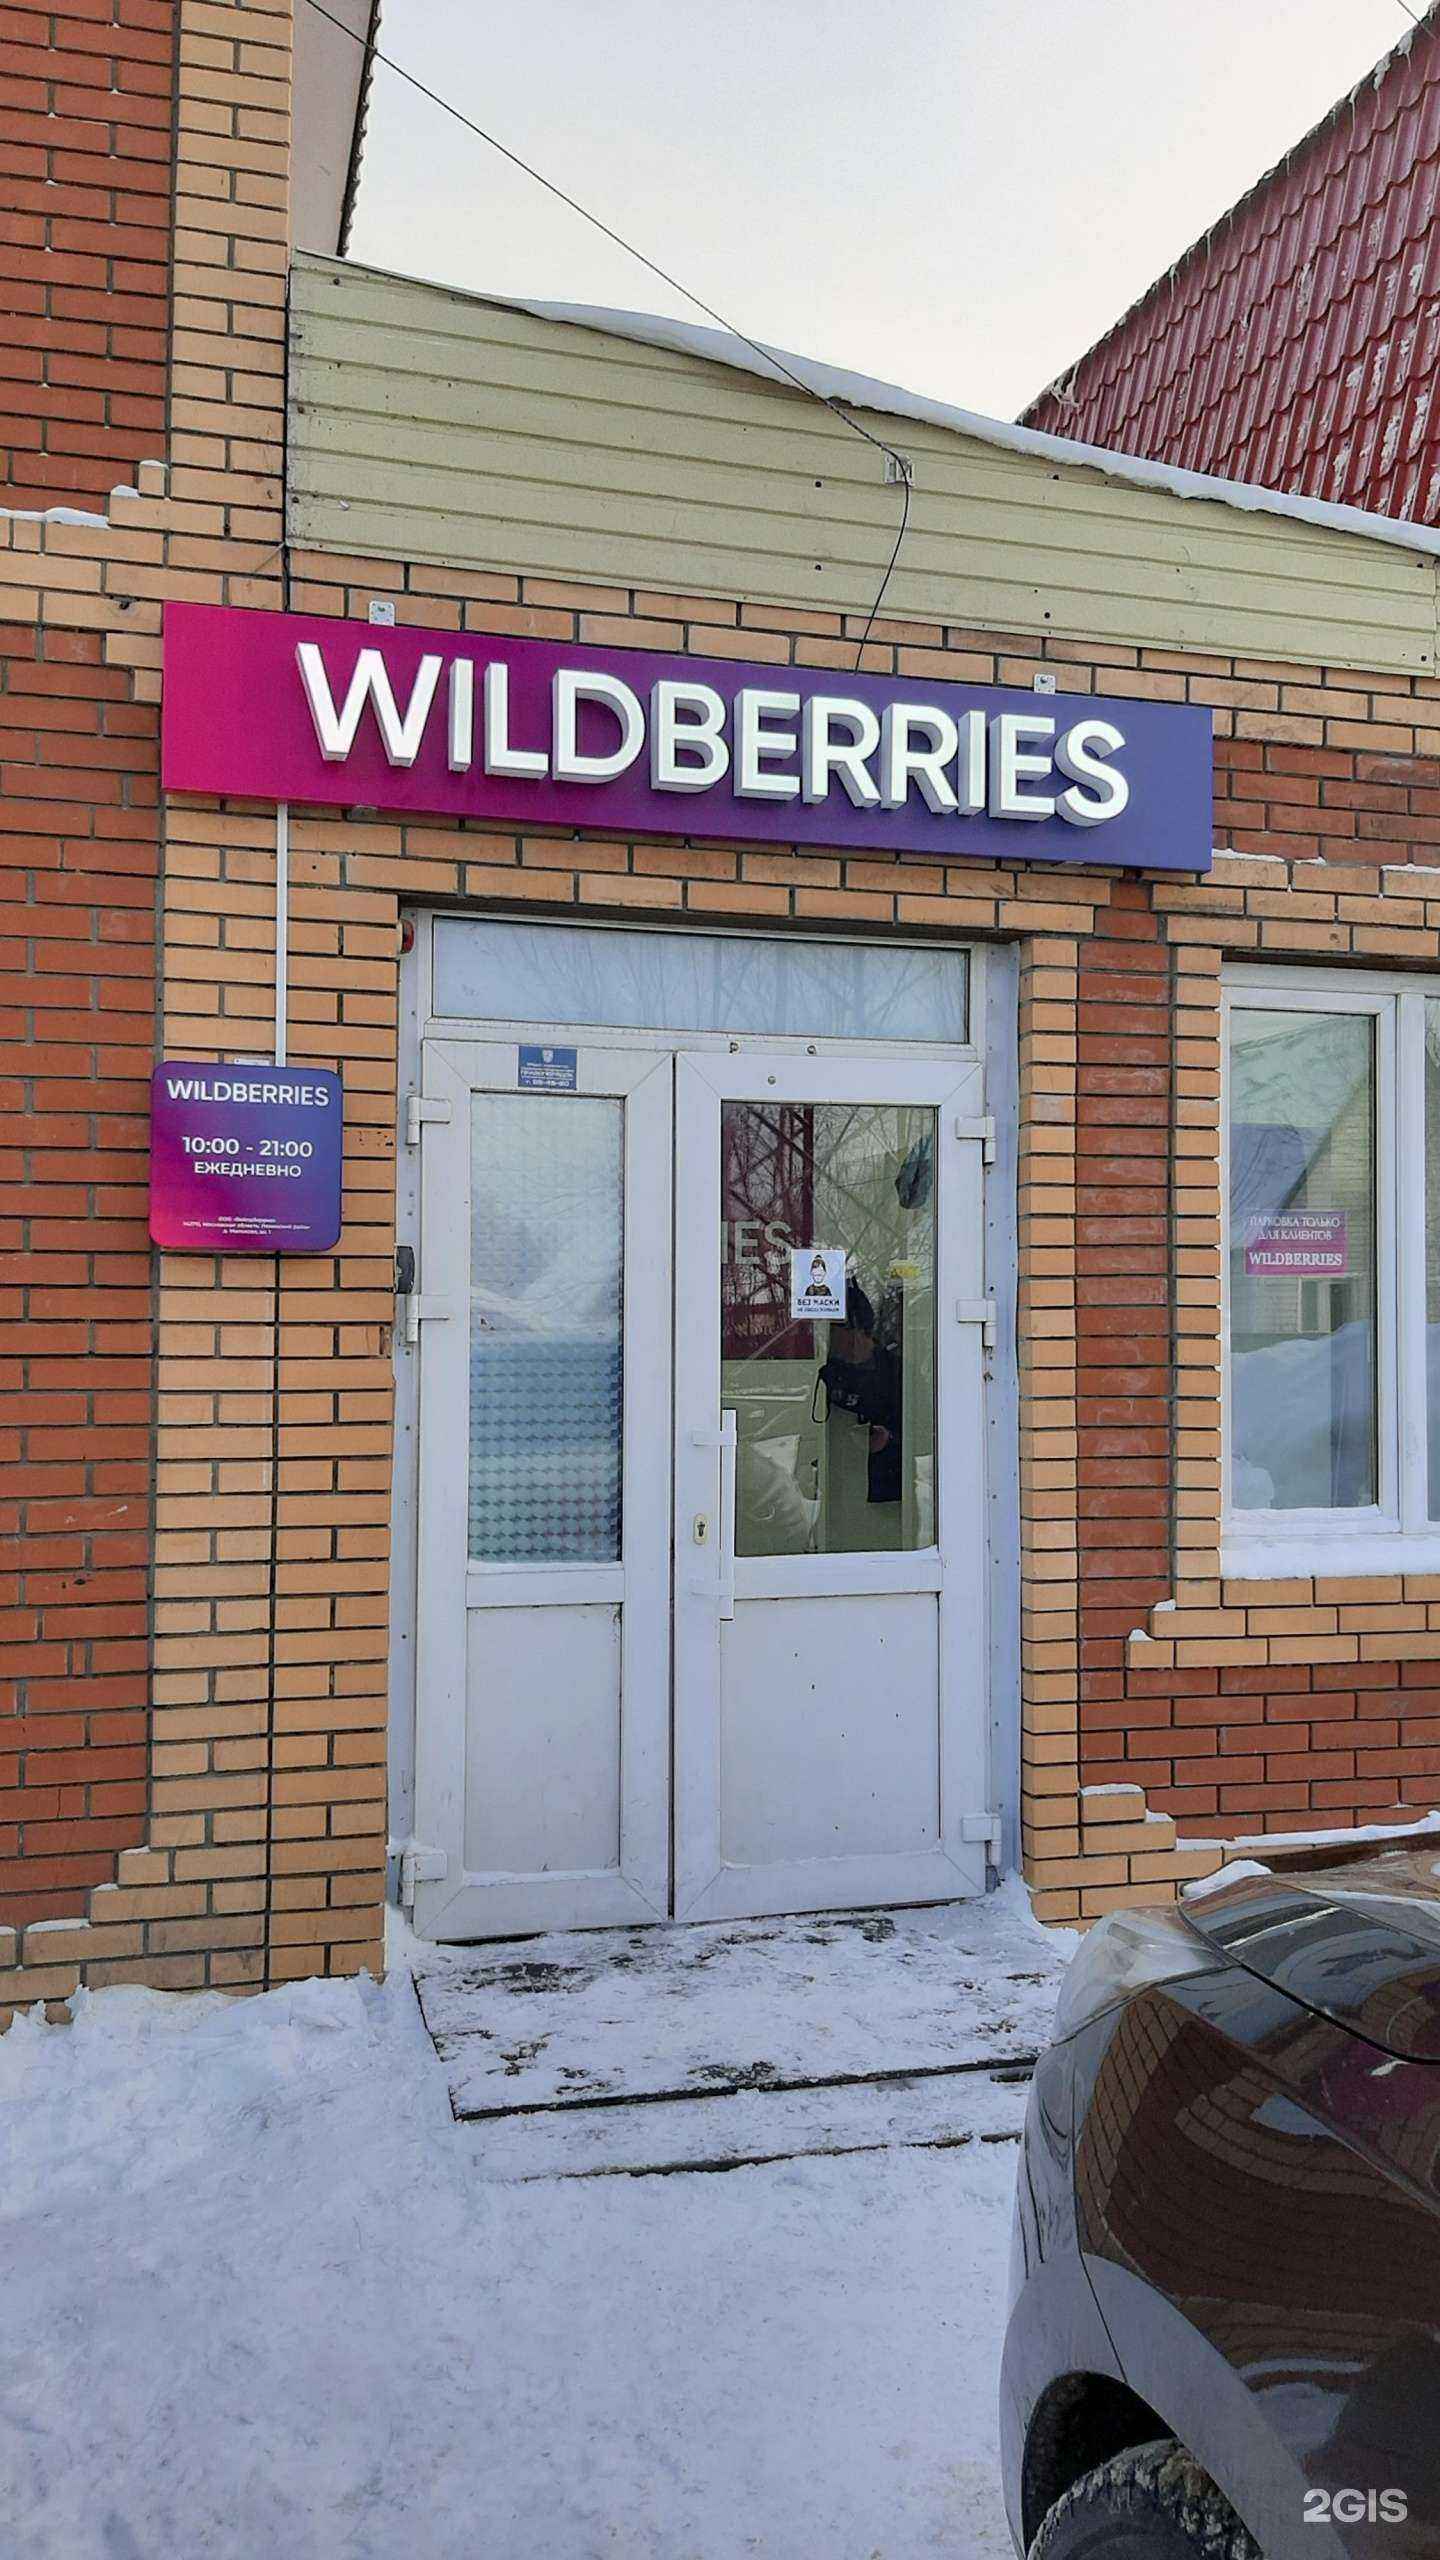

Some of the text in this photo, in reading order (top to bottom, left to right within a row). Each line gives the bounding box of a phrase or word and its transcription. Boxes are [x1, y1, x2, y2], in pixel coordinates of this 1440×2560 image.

[294, 641, 1131, 827] WILDBERRIES
[166, 1079, 330, 1107] WILDBERRIES
[182, 1136, 240, 1155] 10:00
[259, 1139, 313, 1158] 21:00
[194, 1161, 302, 1178] ЕЖЕДНЕВНО
[1248, 1251, 1343, 1267] WILDBERRIES
